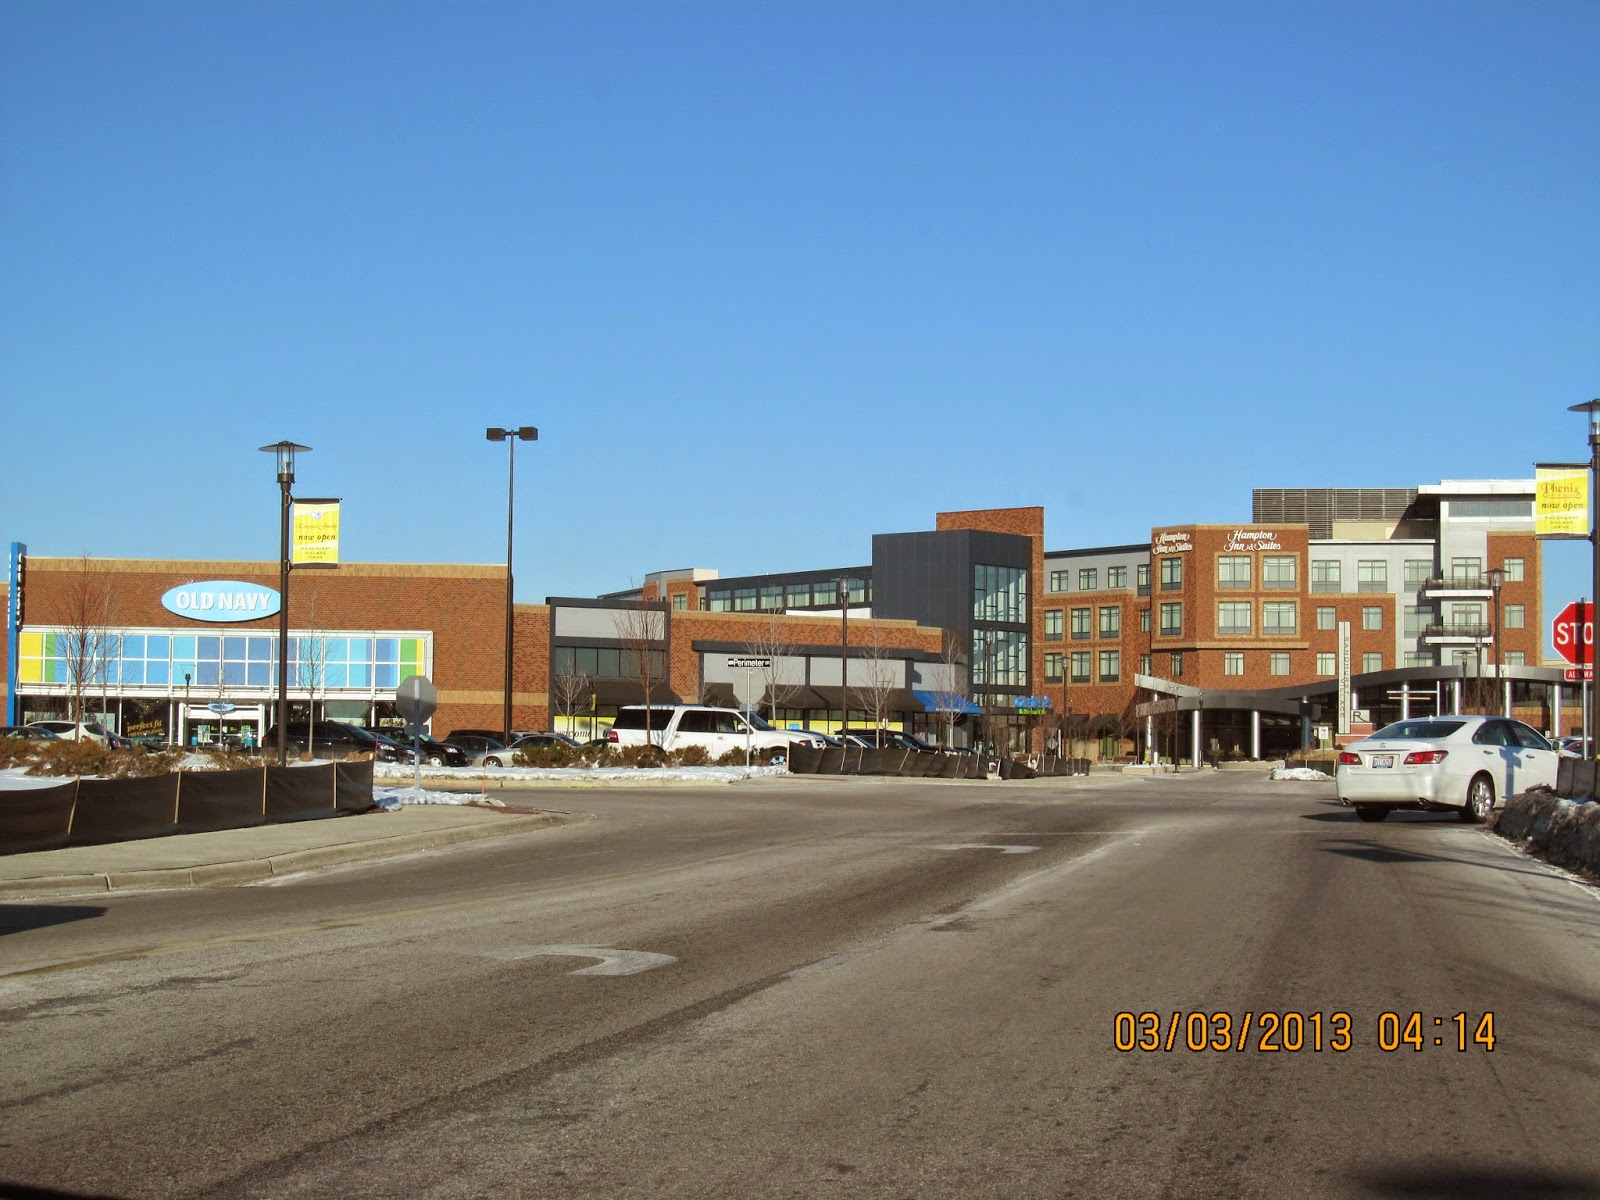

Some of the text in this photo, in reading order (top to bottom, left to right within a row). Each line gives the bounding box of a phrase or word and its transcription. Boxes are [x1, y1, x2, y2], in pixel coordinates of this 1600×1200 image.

[1541, 482, 1580, 494] Phenix
[1563, 502, 1584, 511] open
[317, 534, 336, 542] open
[1155, 532, 1190, 544] Hampton
[1227, 529, 1278, 542] Hampton
[1223, 541, 1249, 552] Inn
[1254, 540, 1281, 551] Suites
[176, 591, 271, 611] OLD NAVY
[1557, 622, 1593, 645] STO
[733, 658, 765, 667] Perimeter
[1568, 670, 1593, 678] ALL WA
[1353, 711, 1368, 722] R
[127, 719, 162, 732] perfect fit
